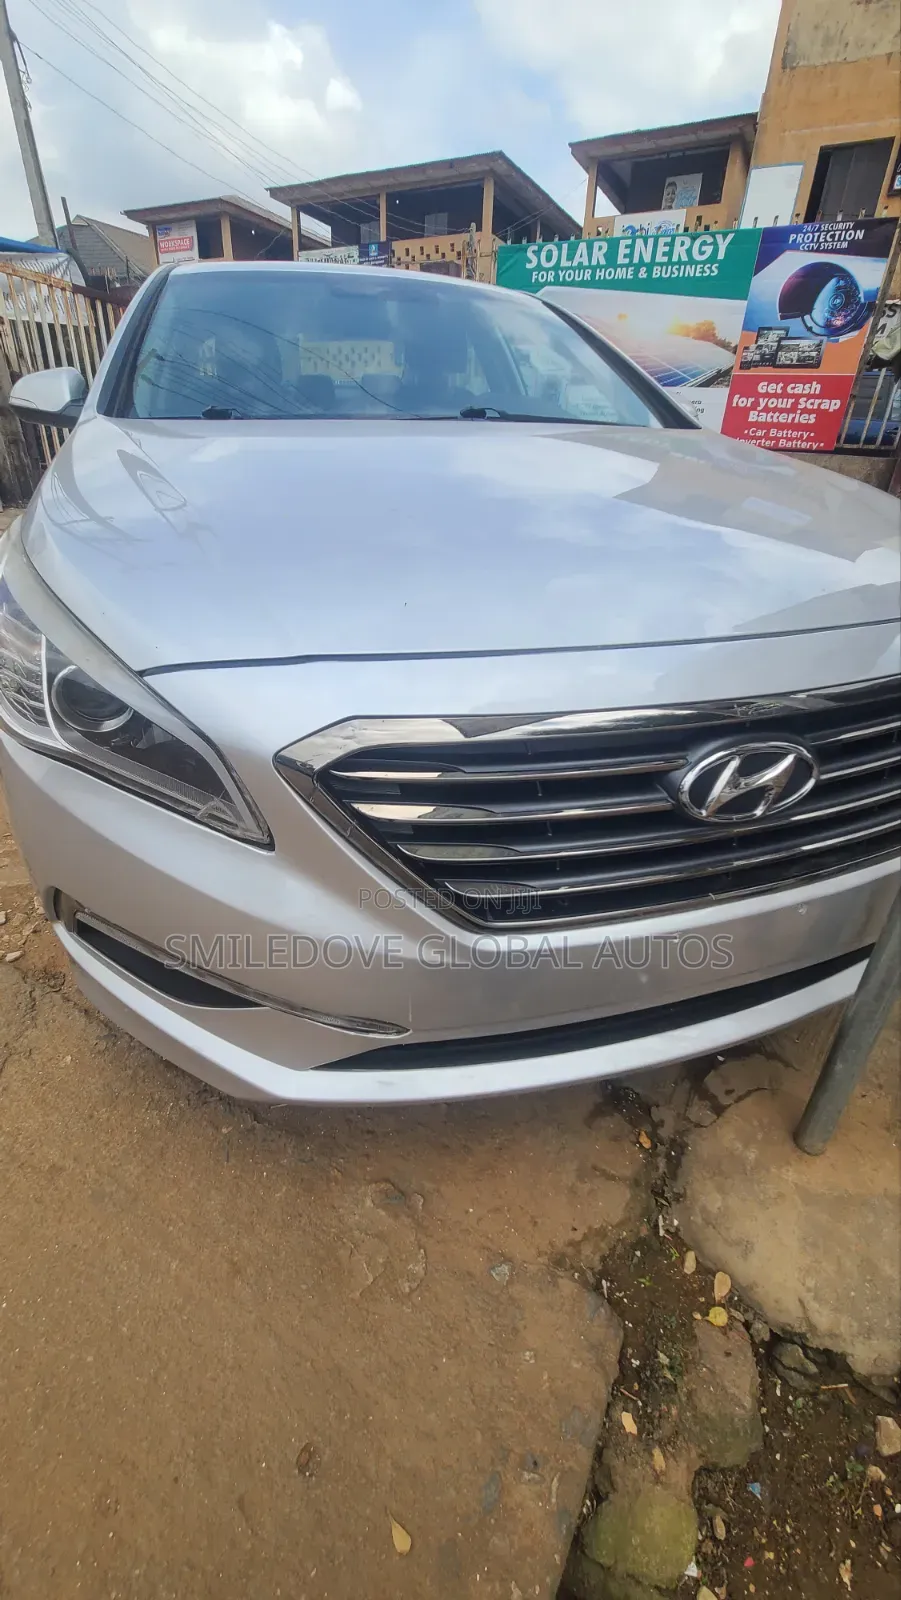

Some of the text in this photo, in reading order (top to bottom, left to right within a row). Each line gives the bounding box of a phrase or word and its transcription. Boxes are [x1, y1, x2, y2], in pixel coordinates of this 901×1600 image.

[802, 222, 855, 233] 24/7 SECURITY
[788, 230, 865, 244] PROTECTION
[525, 232, 735, 269] SOLAR ENERGY
[799, 241, 848, 251] CCTV SYSTEM
[532, 263, 719, 283] FOR YOUR HOME & BUSINESS
[757, 381, 821, 394] Get cash
[732, 394, 754, 407] for
[756, 397, 795, 410] your
[747, 410, 816, 424] Batteries
